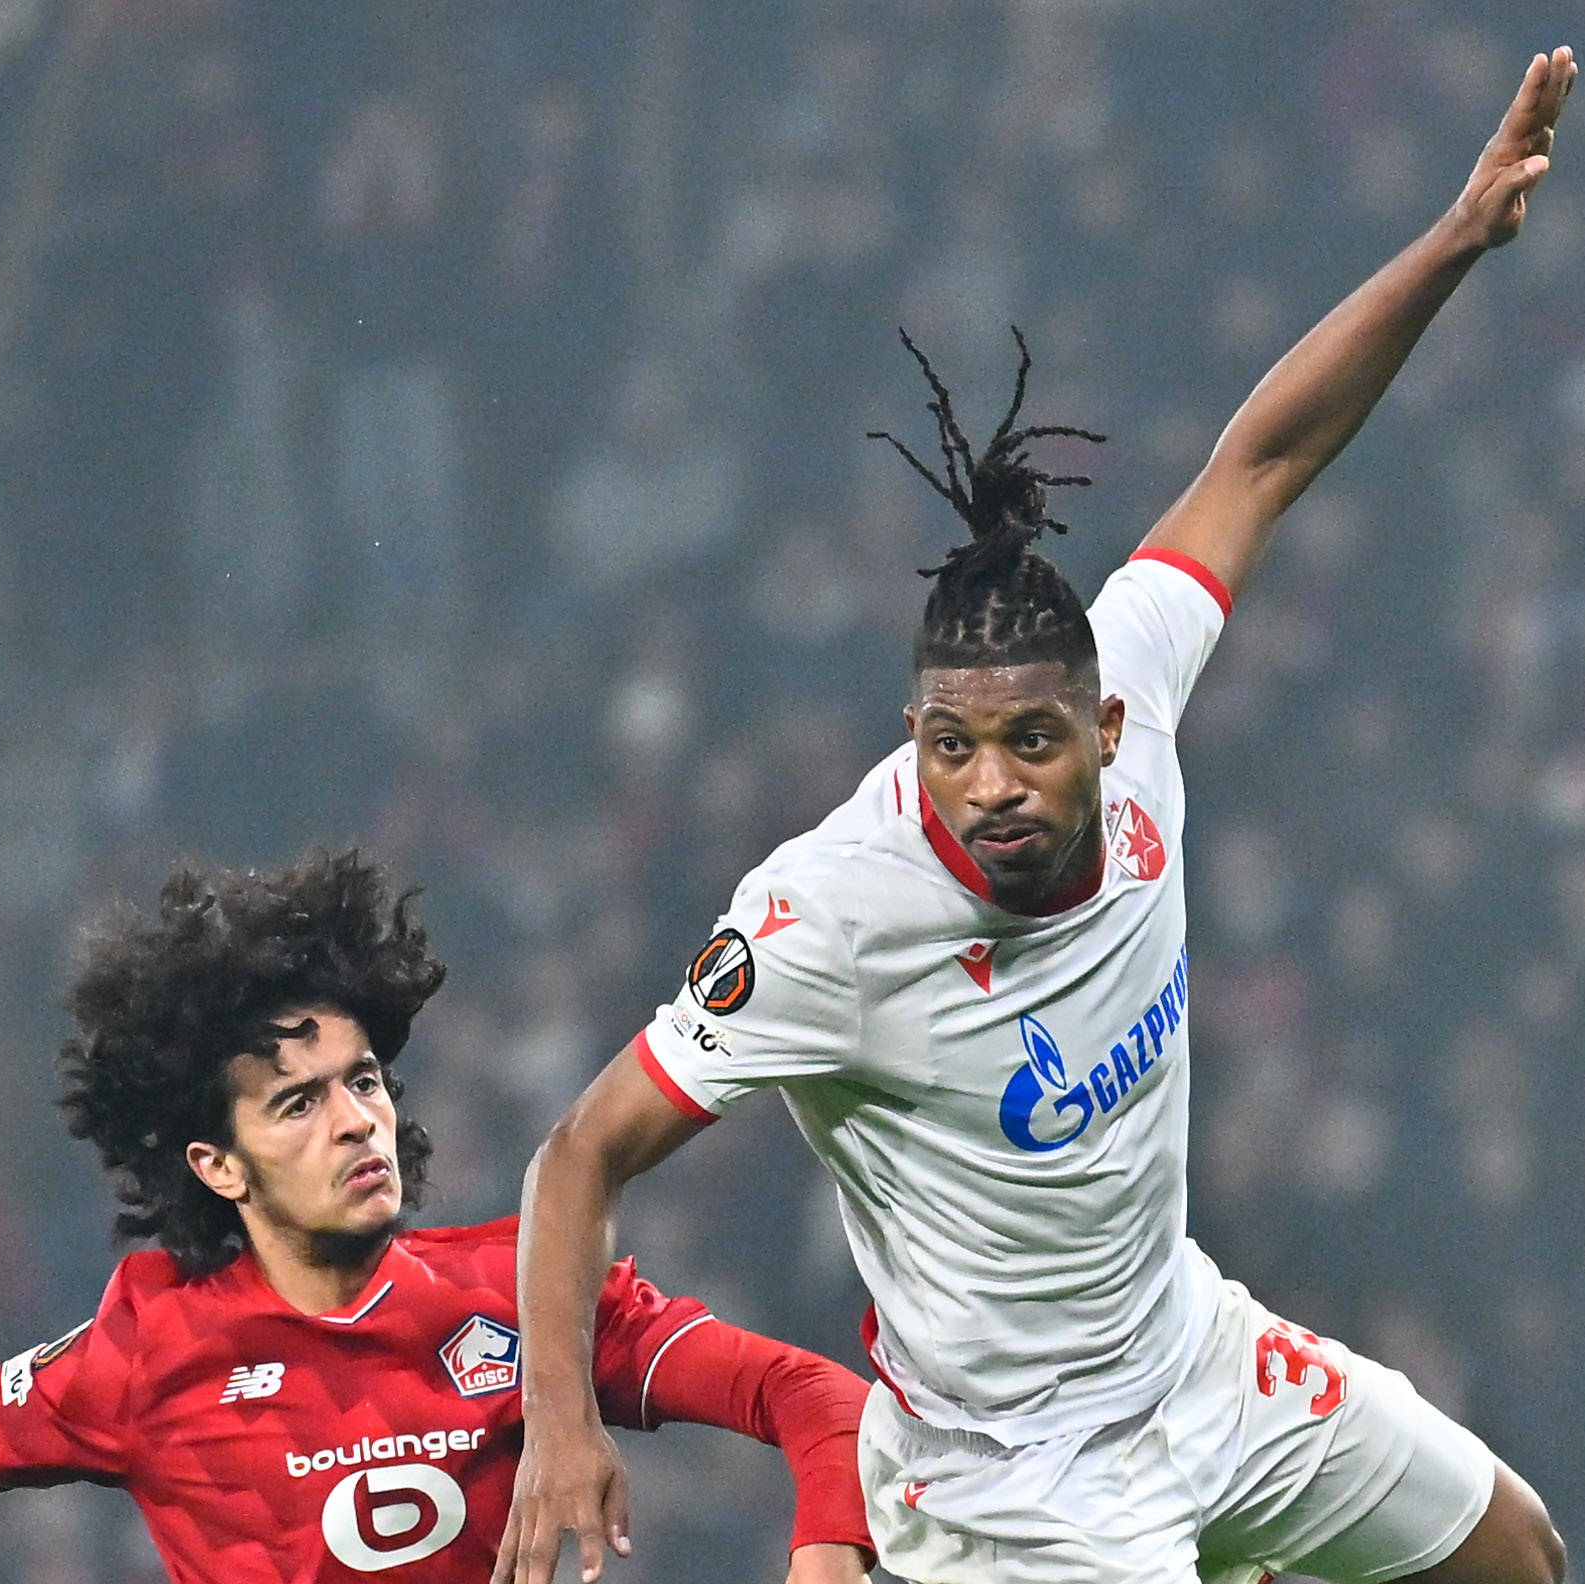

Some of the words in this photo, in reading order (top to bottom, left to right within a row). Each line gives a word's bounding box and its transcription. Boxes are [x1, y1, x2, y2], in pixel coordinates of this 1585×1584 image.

[1089, 943, 1189, 1114] GAZPRO
[218, 1362, 286, 1405] NB
[464, 1367, 510, 1389] LOSC
[1256, 1321, 1347, 1417] 3
[285, 1428, 486, 1478] boulanger
